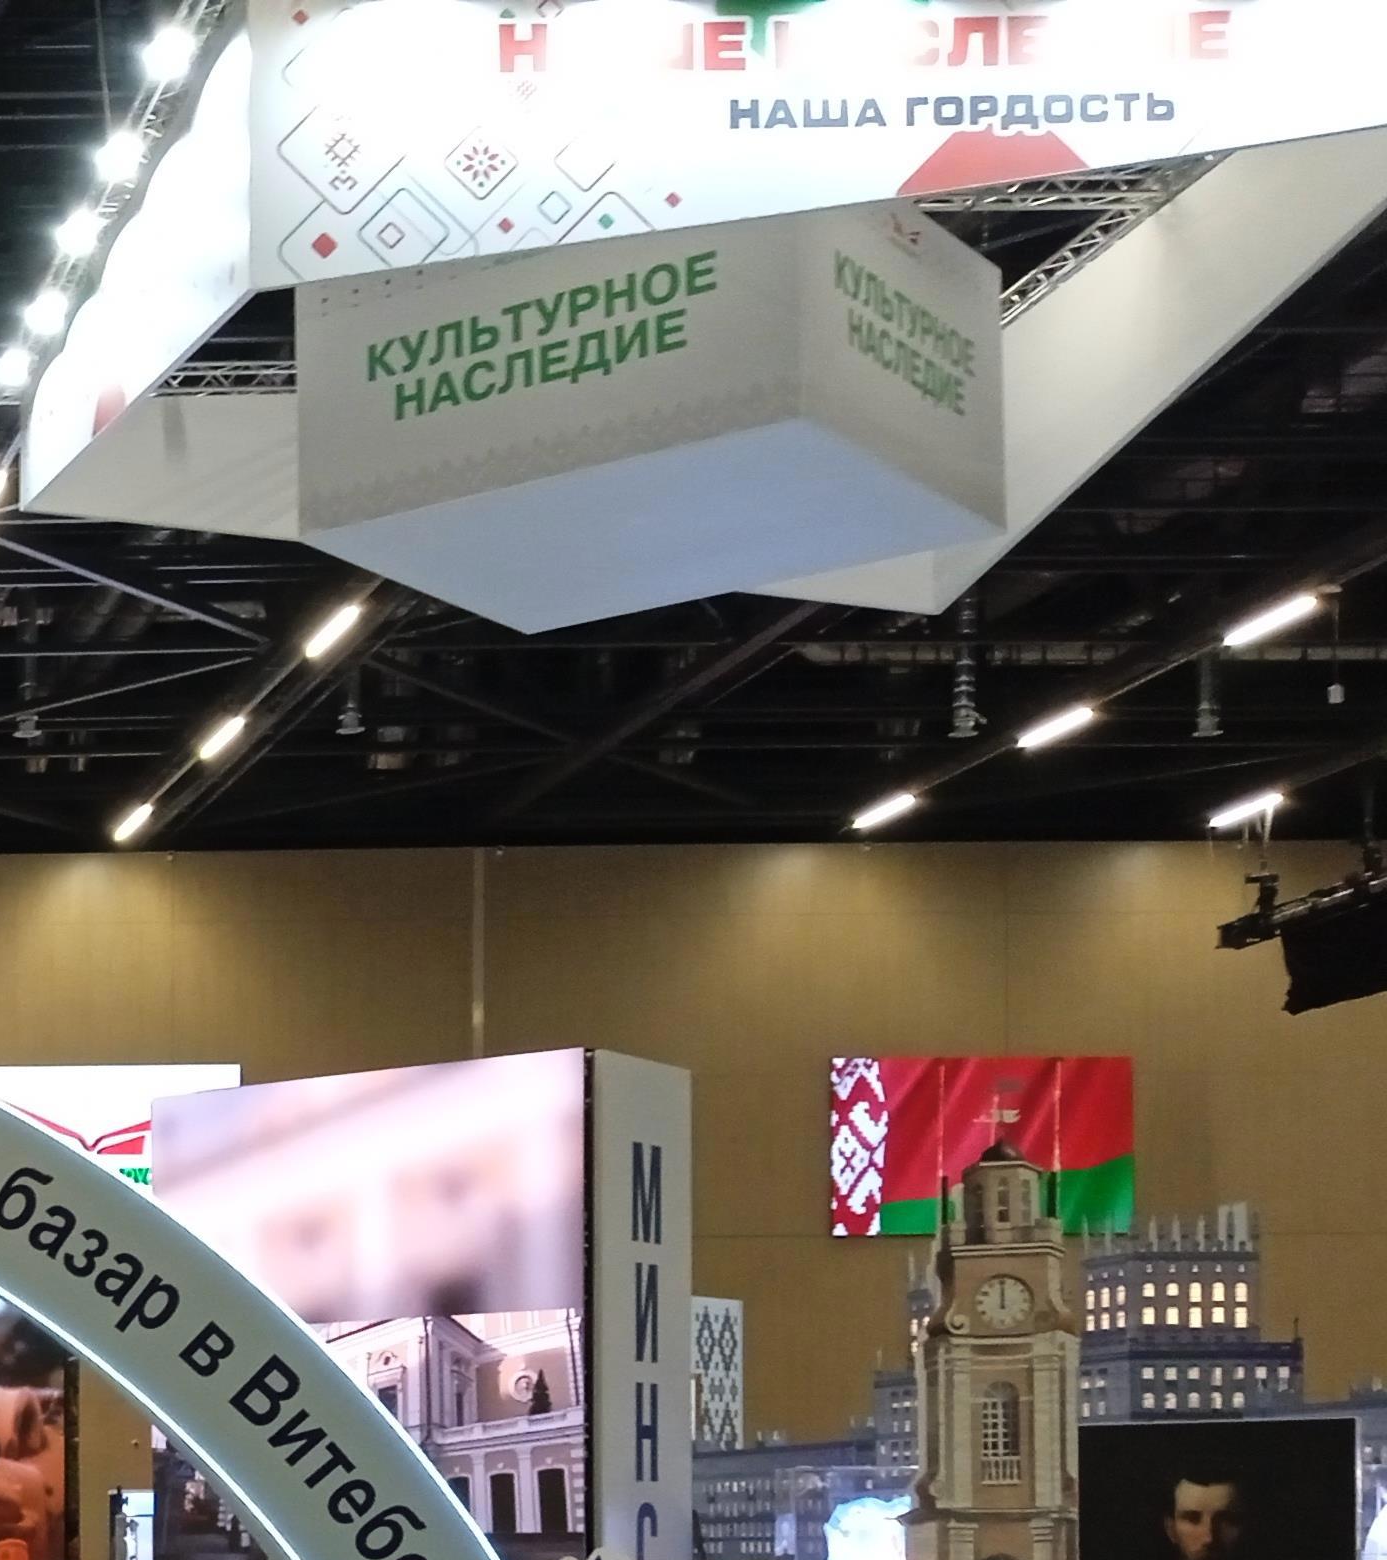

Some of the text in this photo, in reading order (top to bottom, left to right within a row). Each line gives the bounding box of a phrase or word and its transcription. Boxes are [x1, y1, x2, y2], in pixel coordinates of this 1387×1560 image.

[729, 91, 1176, 132] НАША ГОРДОСТЬ
[366, 250, 718, 383] КУЛЬТУРНОЕ
[394, 308, 689, 421] НАСЛЕДИЕ
[833, 249, 977, 378] КУЛЬТУРНОЕ
[847, 307, 966, 417] НАСЛЕДИЕ
[179, 1322, 236, 1377] в
